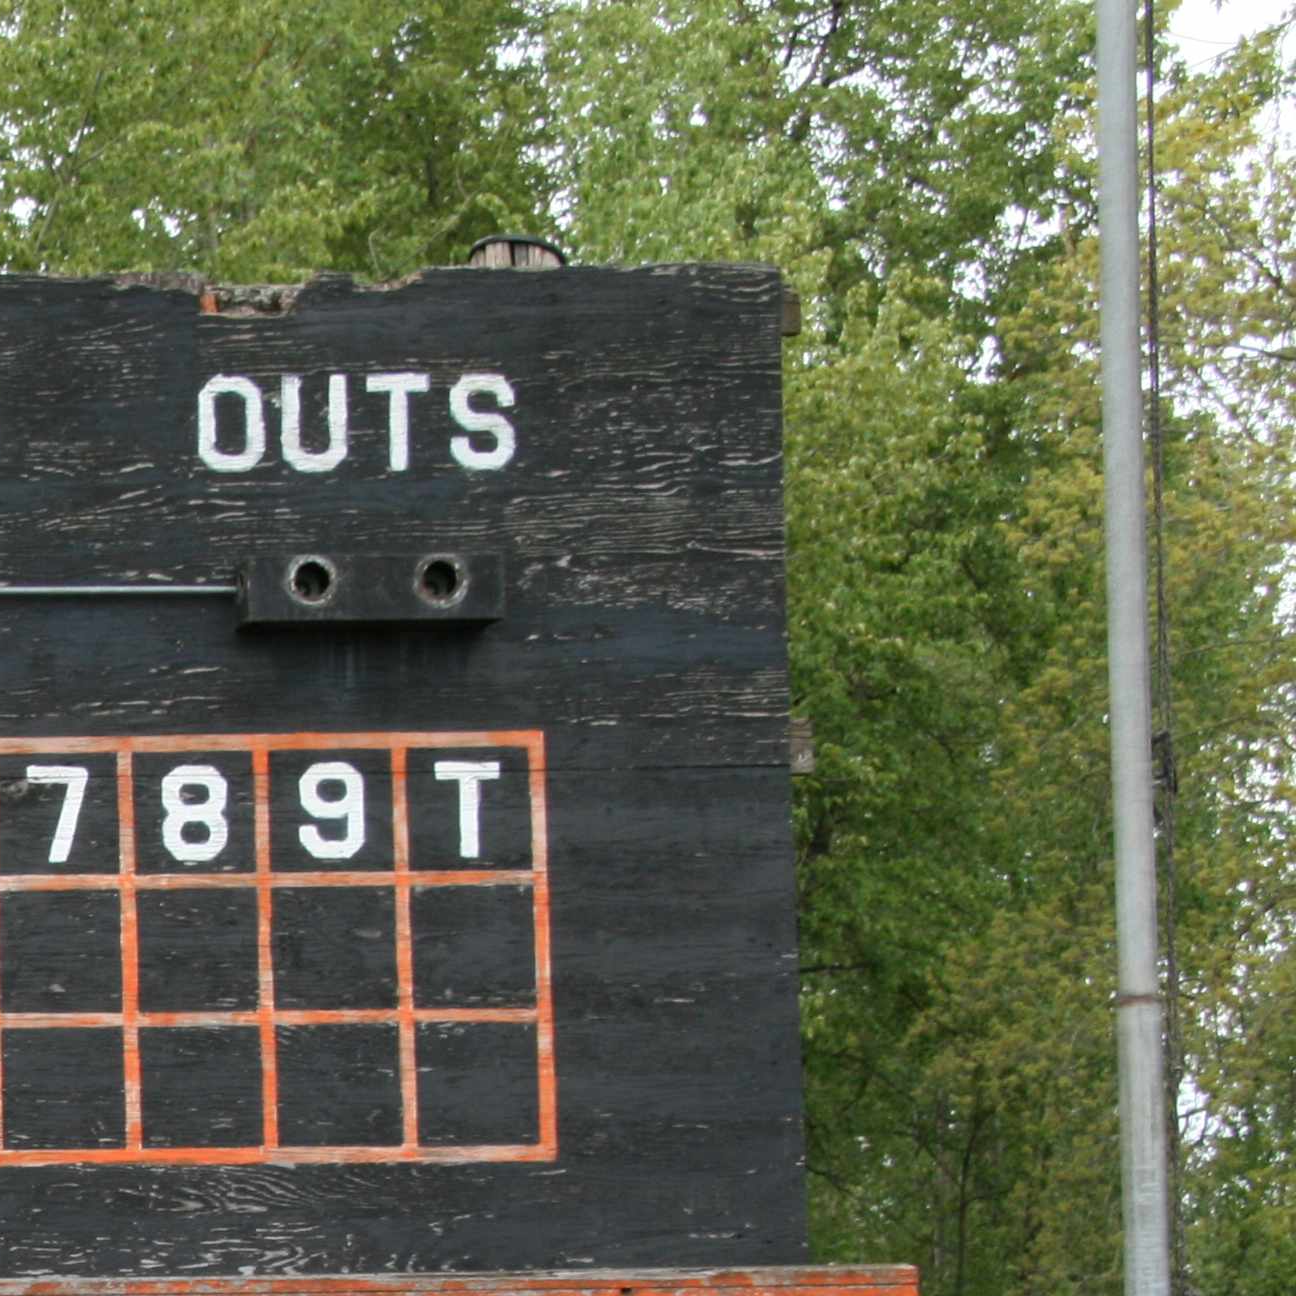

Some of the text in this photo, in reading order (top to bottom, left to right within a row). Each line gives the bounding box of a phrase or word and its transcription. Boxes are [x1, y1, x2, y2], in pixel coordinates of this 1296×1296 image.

[197, 373, 517, 473] OUTS
[26, 765, 88, 863] 7
[161, 764, 228, 862] 8
[297, 762, 365, 860] 9
[434, 761, 500, 859] T
